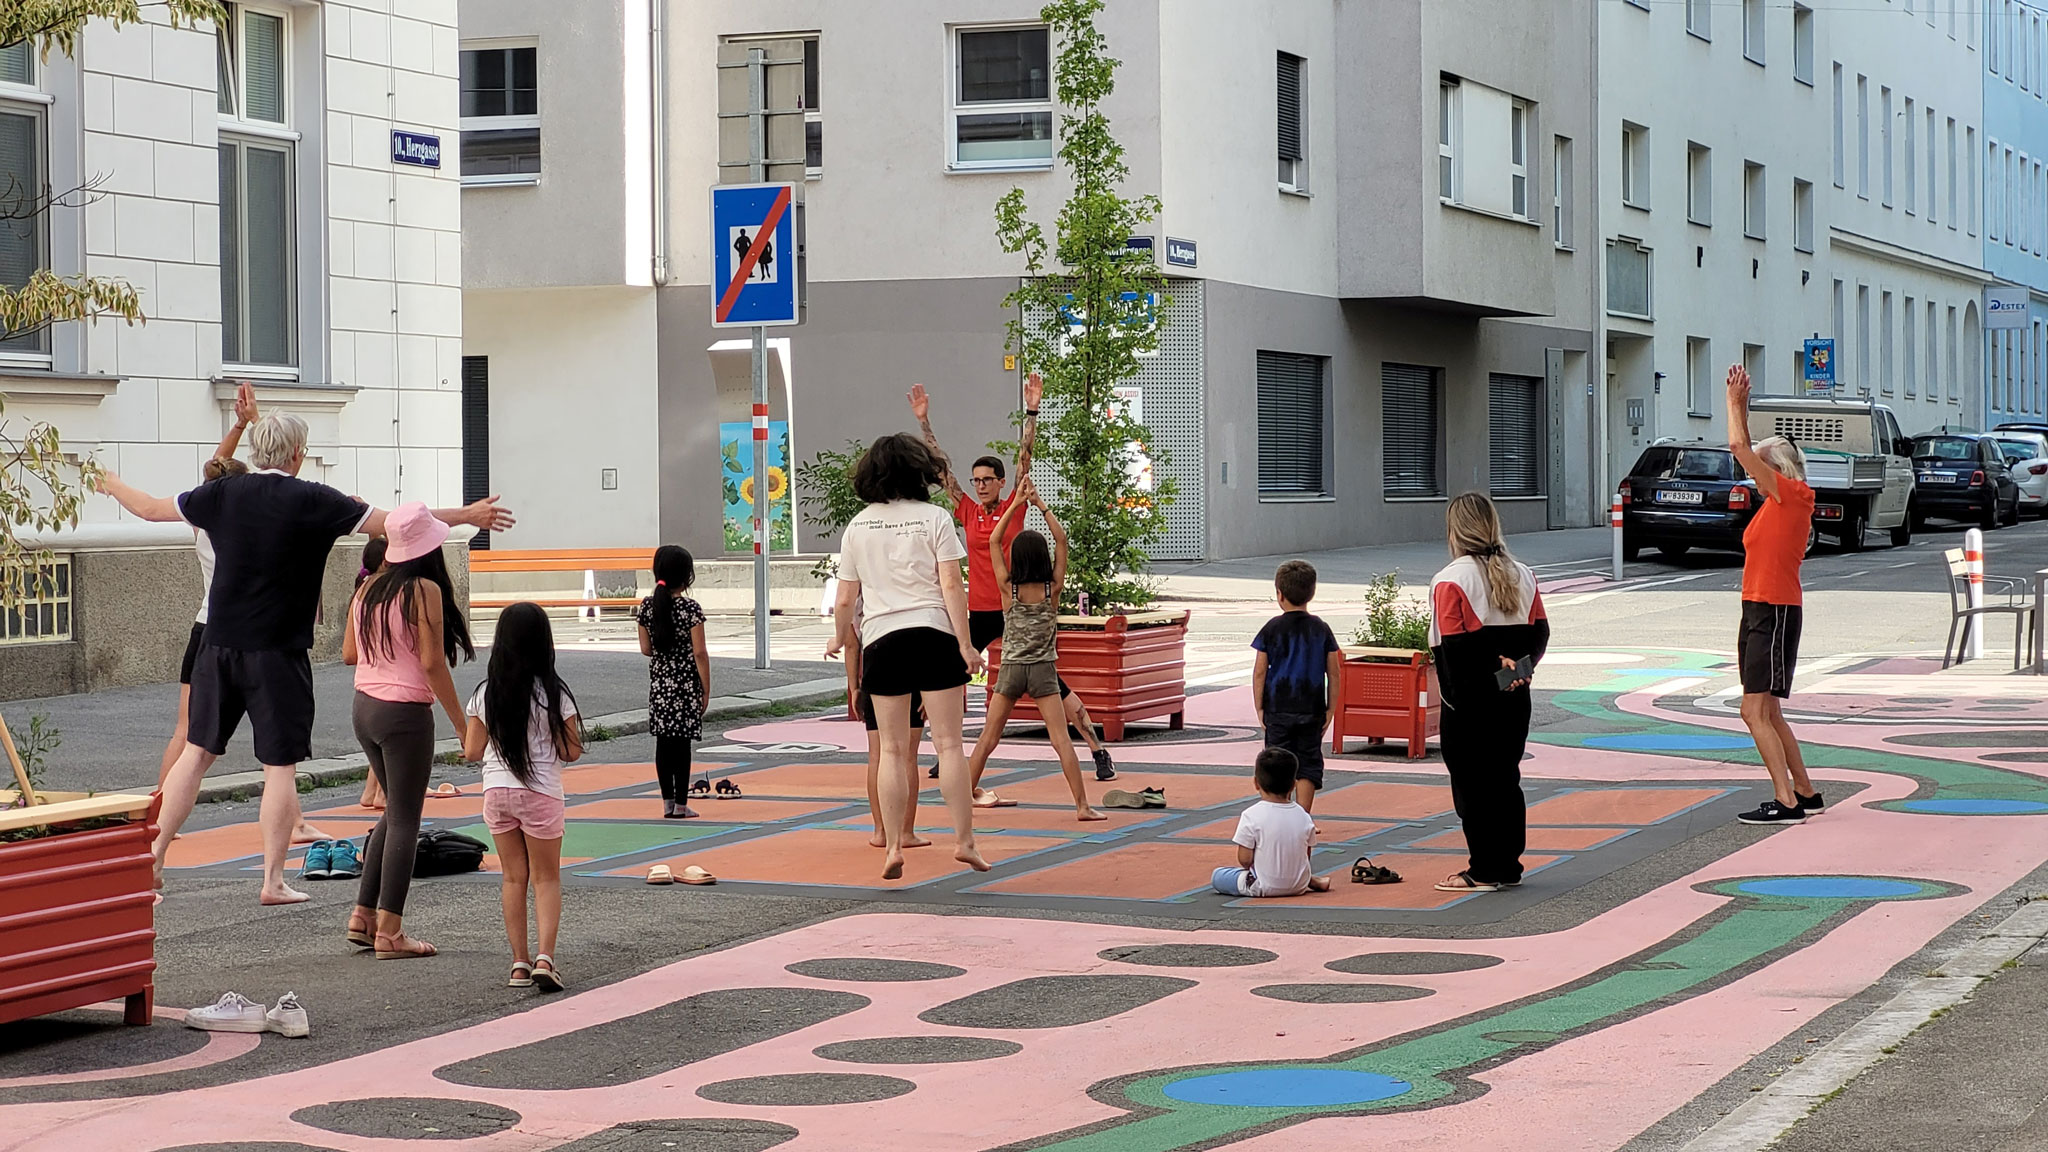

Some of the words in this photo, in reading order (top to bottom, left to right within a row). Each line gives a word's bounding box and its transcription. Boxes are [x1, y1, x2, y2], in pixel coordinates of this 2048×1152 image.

[394, 135, 406, 159] 10.,
[406, 136, 439, 164] Herzgasse
[1991, 299, 2026, 310] DESTEX
